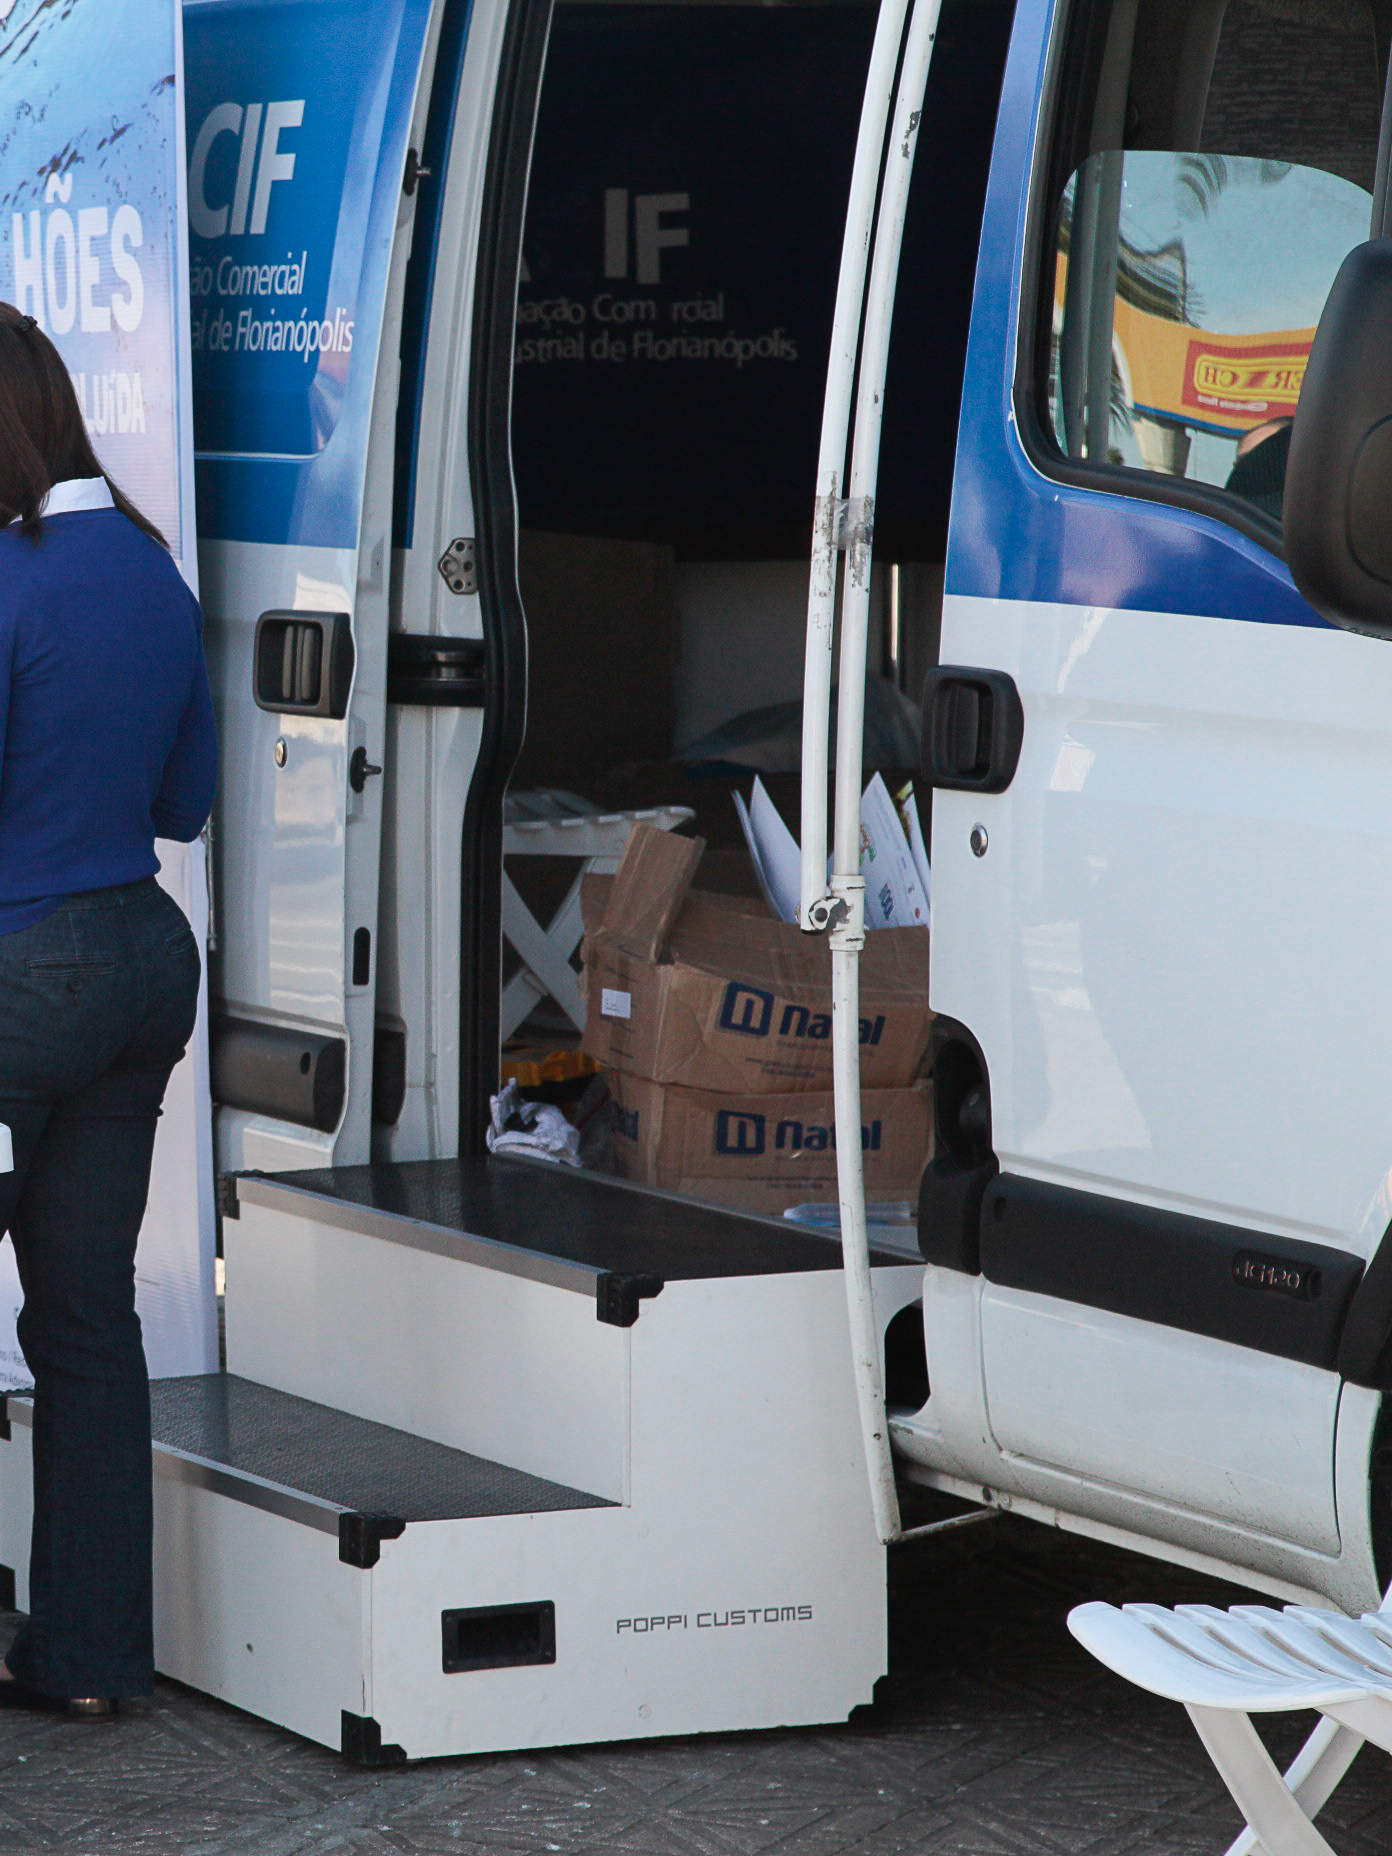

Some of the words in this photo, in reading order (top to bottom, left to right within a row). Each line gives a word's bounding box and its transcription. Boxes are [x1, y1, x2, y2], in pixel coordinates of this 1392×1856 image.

[216, 250, 307, 296] Comercial
[209, 308, 233, 351] de
[235, 307, 355, 364] Florianópolis
[590, 331, 626, 363] de
[633, 327, 799, 369] Florianópolis
[616, 1614, 688, 1634] POPPI
[696, 1605, 813, 1628] CUSTOMS
